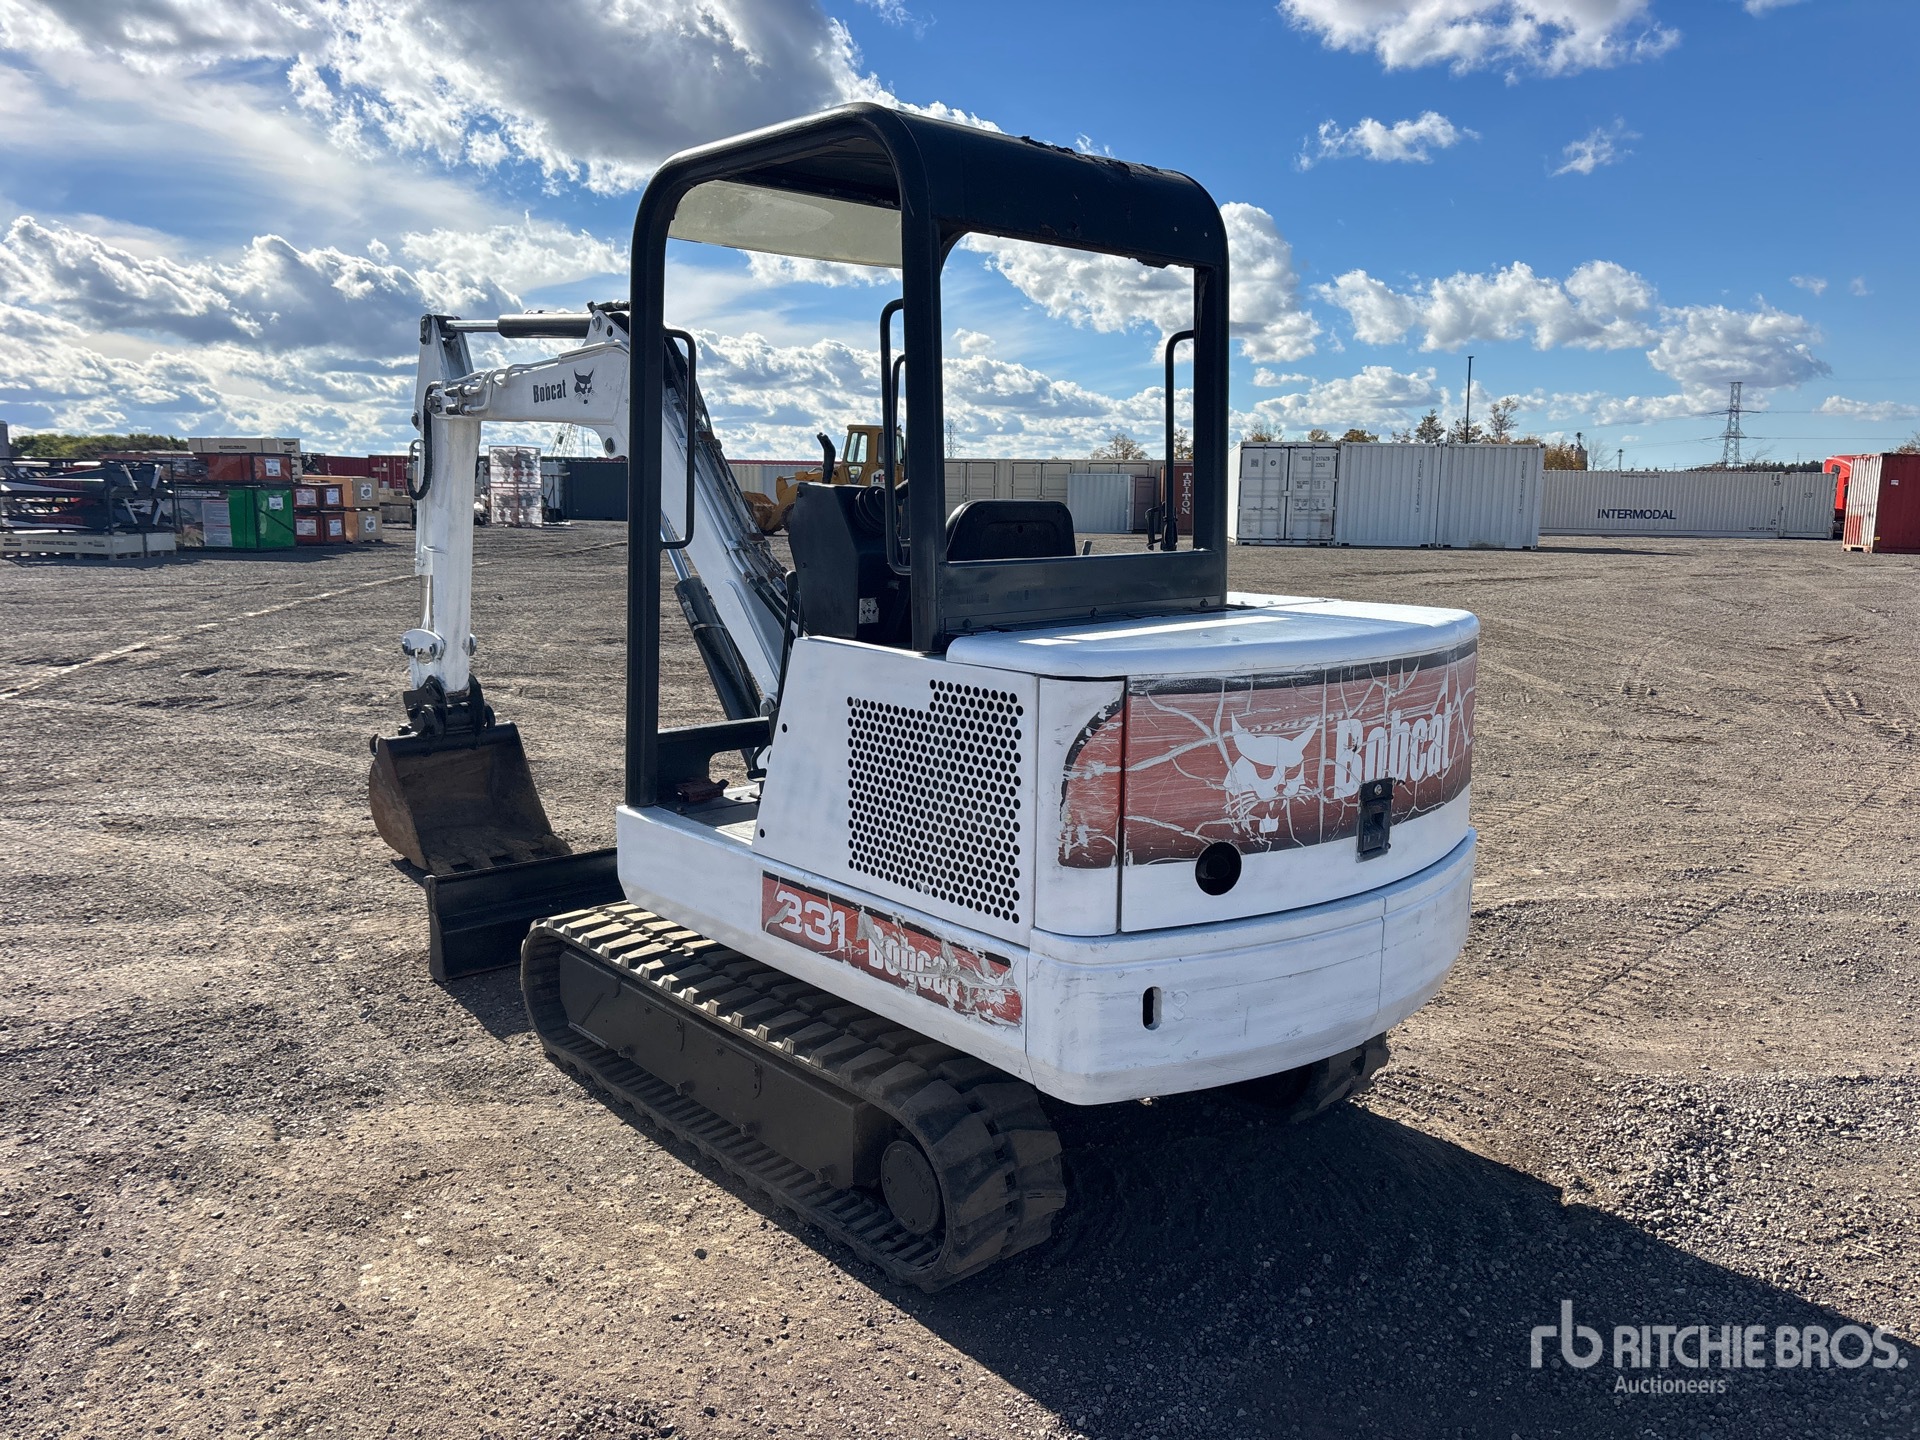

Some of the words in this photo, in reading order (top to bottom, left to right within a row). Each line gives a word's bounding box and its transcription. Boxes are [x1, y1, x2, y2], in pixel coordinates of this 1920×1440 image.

[533, 379, 566, 403] Bobcat
[1181, 472, 1192, 514] TRITON
[1597, 508, 1677, 520] INTERMODAL
[1334, 704, 1452, 799] Bobcat
[776, 890, 846, 952] 331
